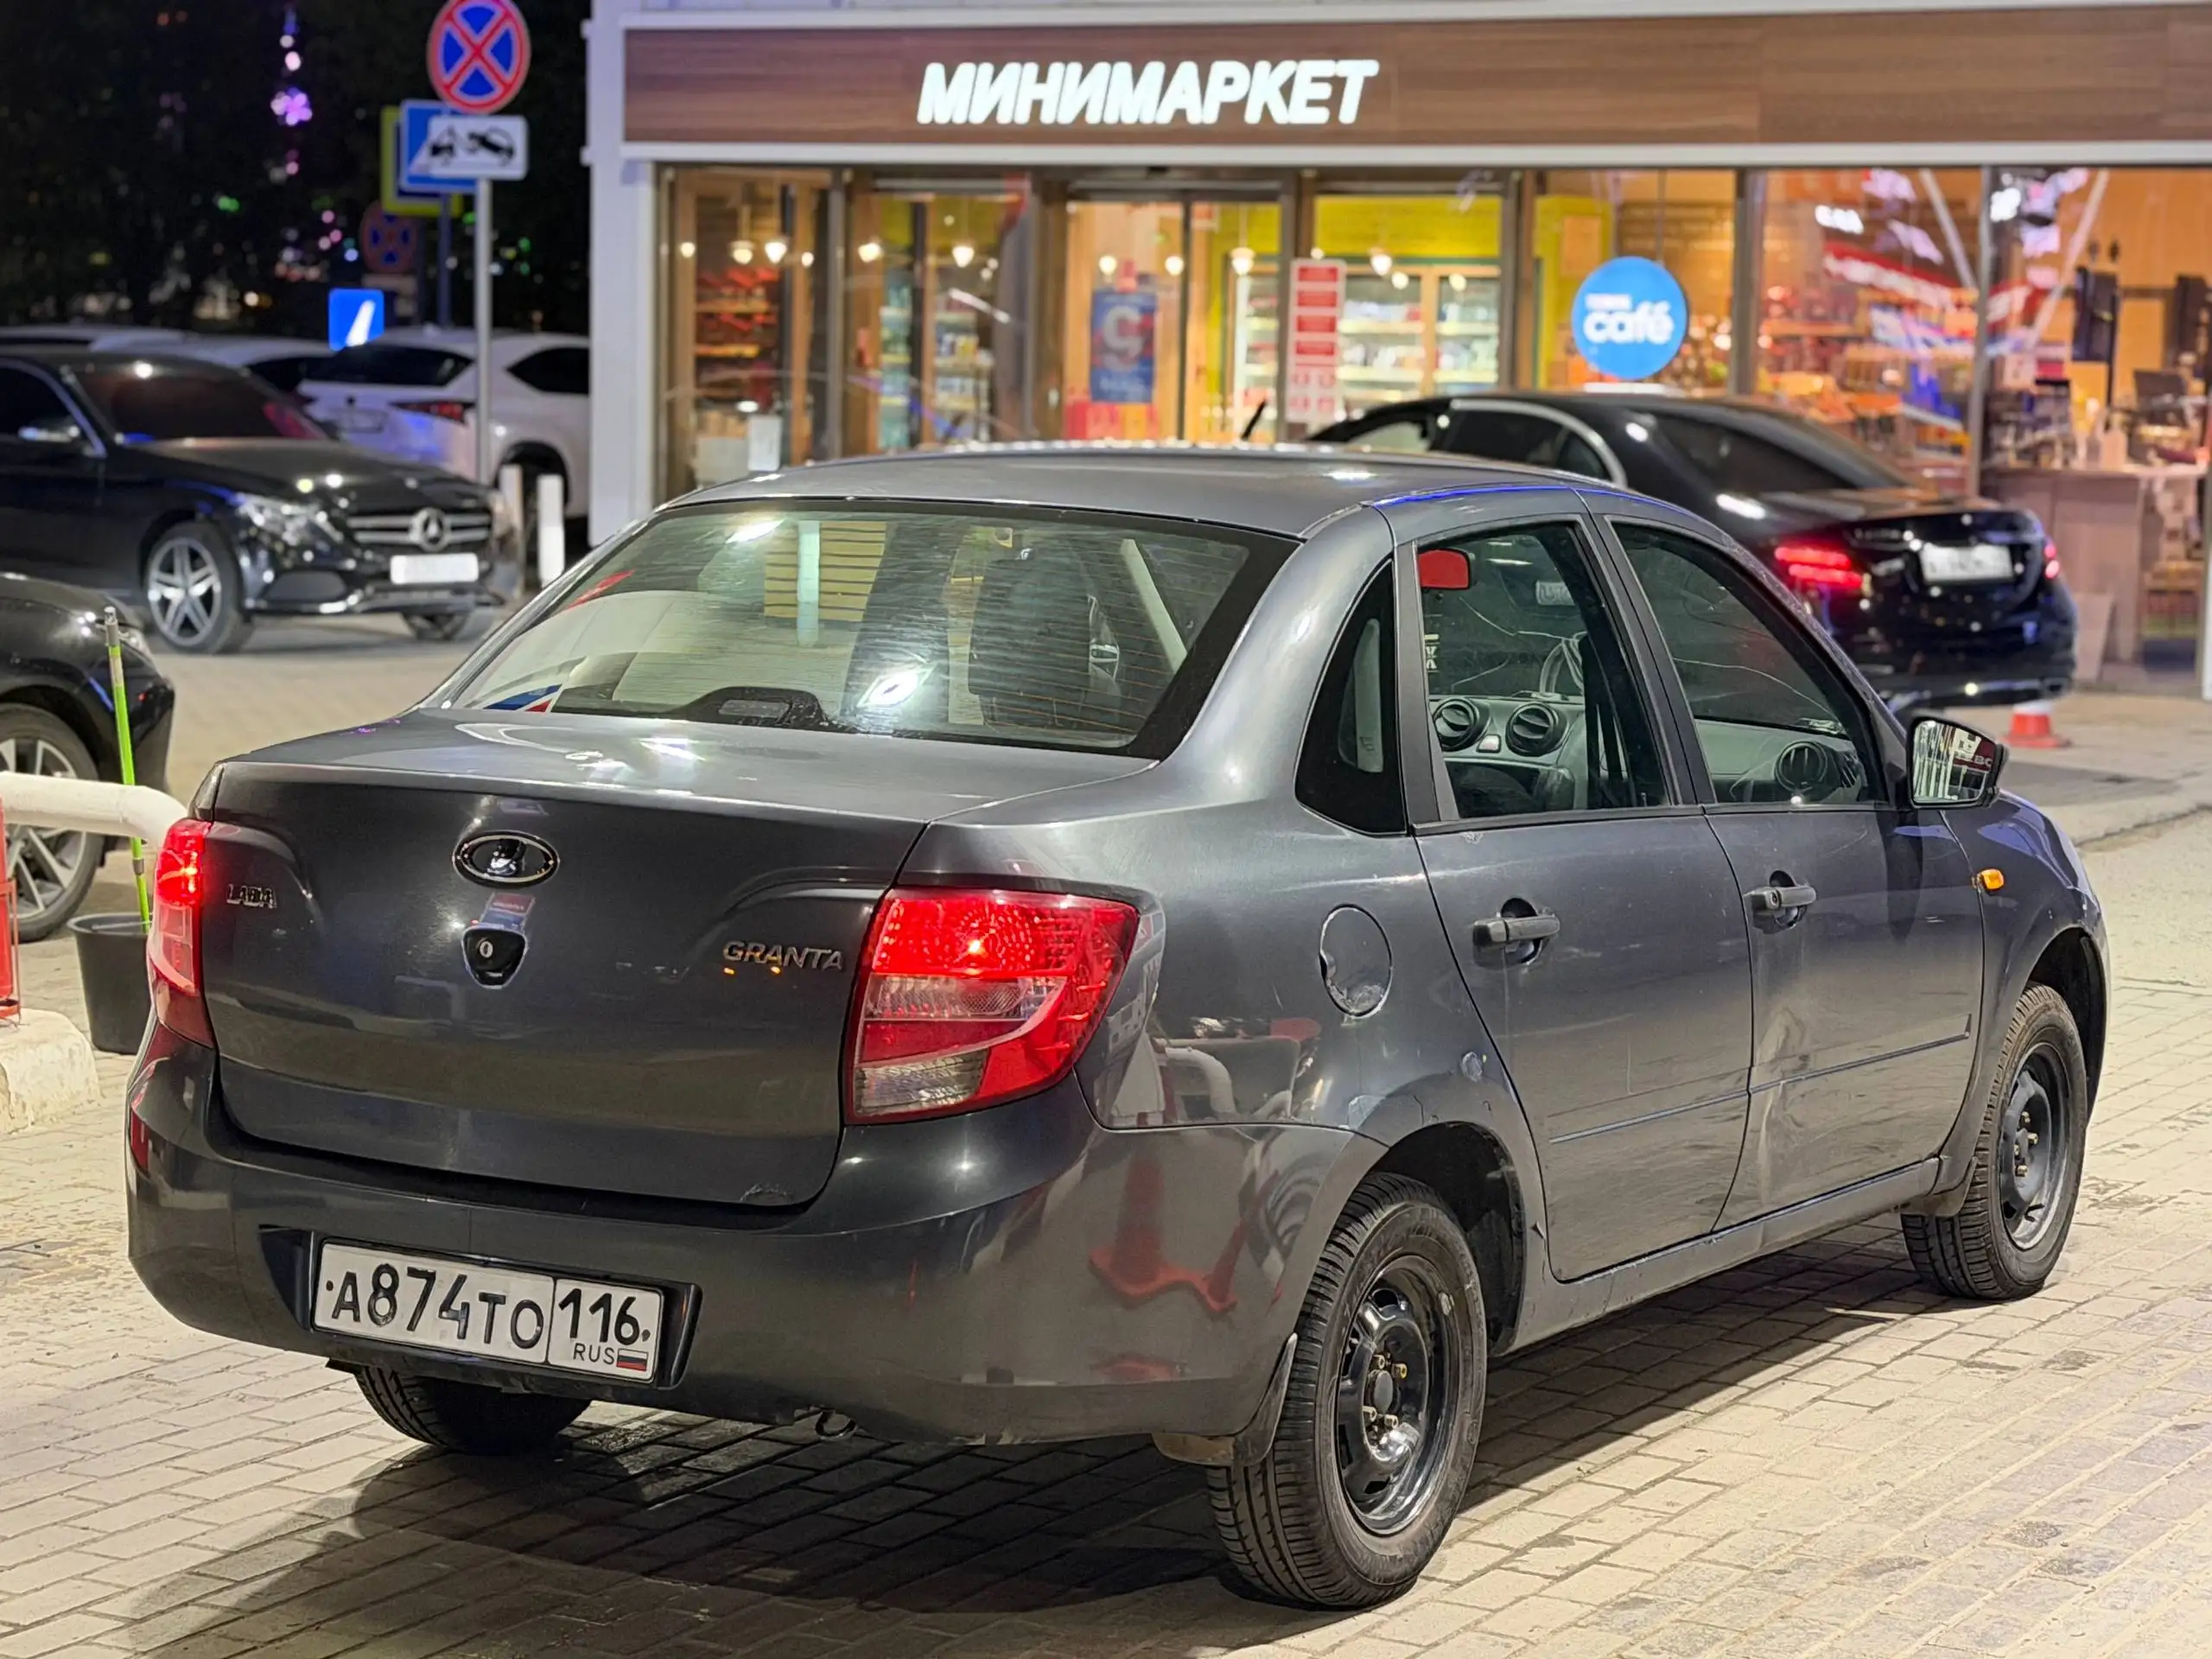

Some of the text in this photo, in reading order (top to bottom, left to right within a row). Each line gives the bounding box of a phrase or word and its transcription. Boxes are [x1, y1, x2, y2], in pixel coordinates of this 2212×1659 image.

[917, 60, 1380, 125] МИНИМАРКЕТ
[722, 941, 843, 970] GRANTA
[332, 1262, 640, 1350] А874ТО 116
[573, 1343, 615, 1365] RUS
